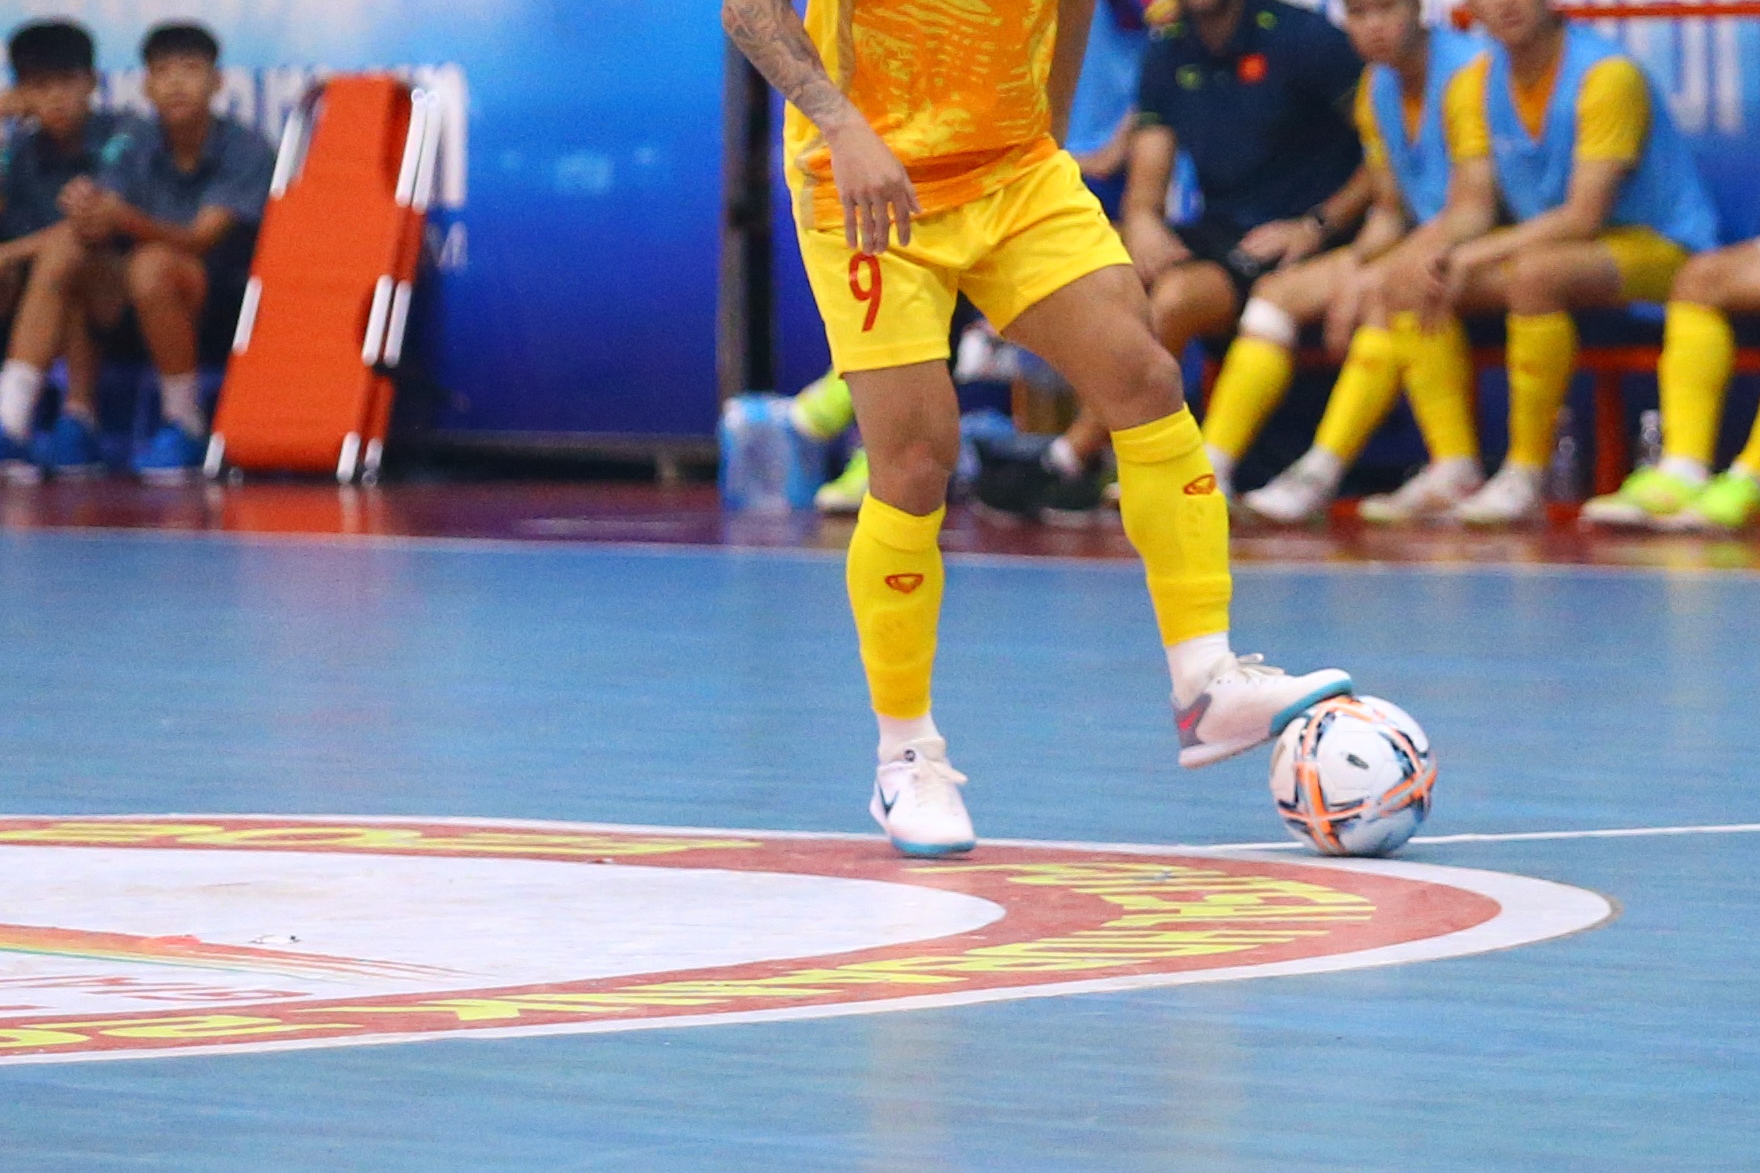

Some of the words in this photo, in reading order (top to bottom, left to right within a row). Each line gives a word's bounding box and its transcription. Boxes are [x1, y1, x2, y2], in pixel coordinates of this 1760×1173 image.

[848, 251, 883, 333] 9
[905, 862, 1377, 927] FUTSAL
[291, 930, 1331, 1021] HDBANK
